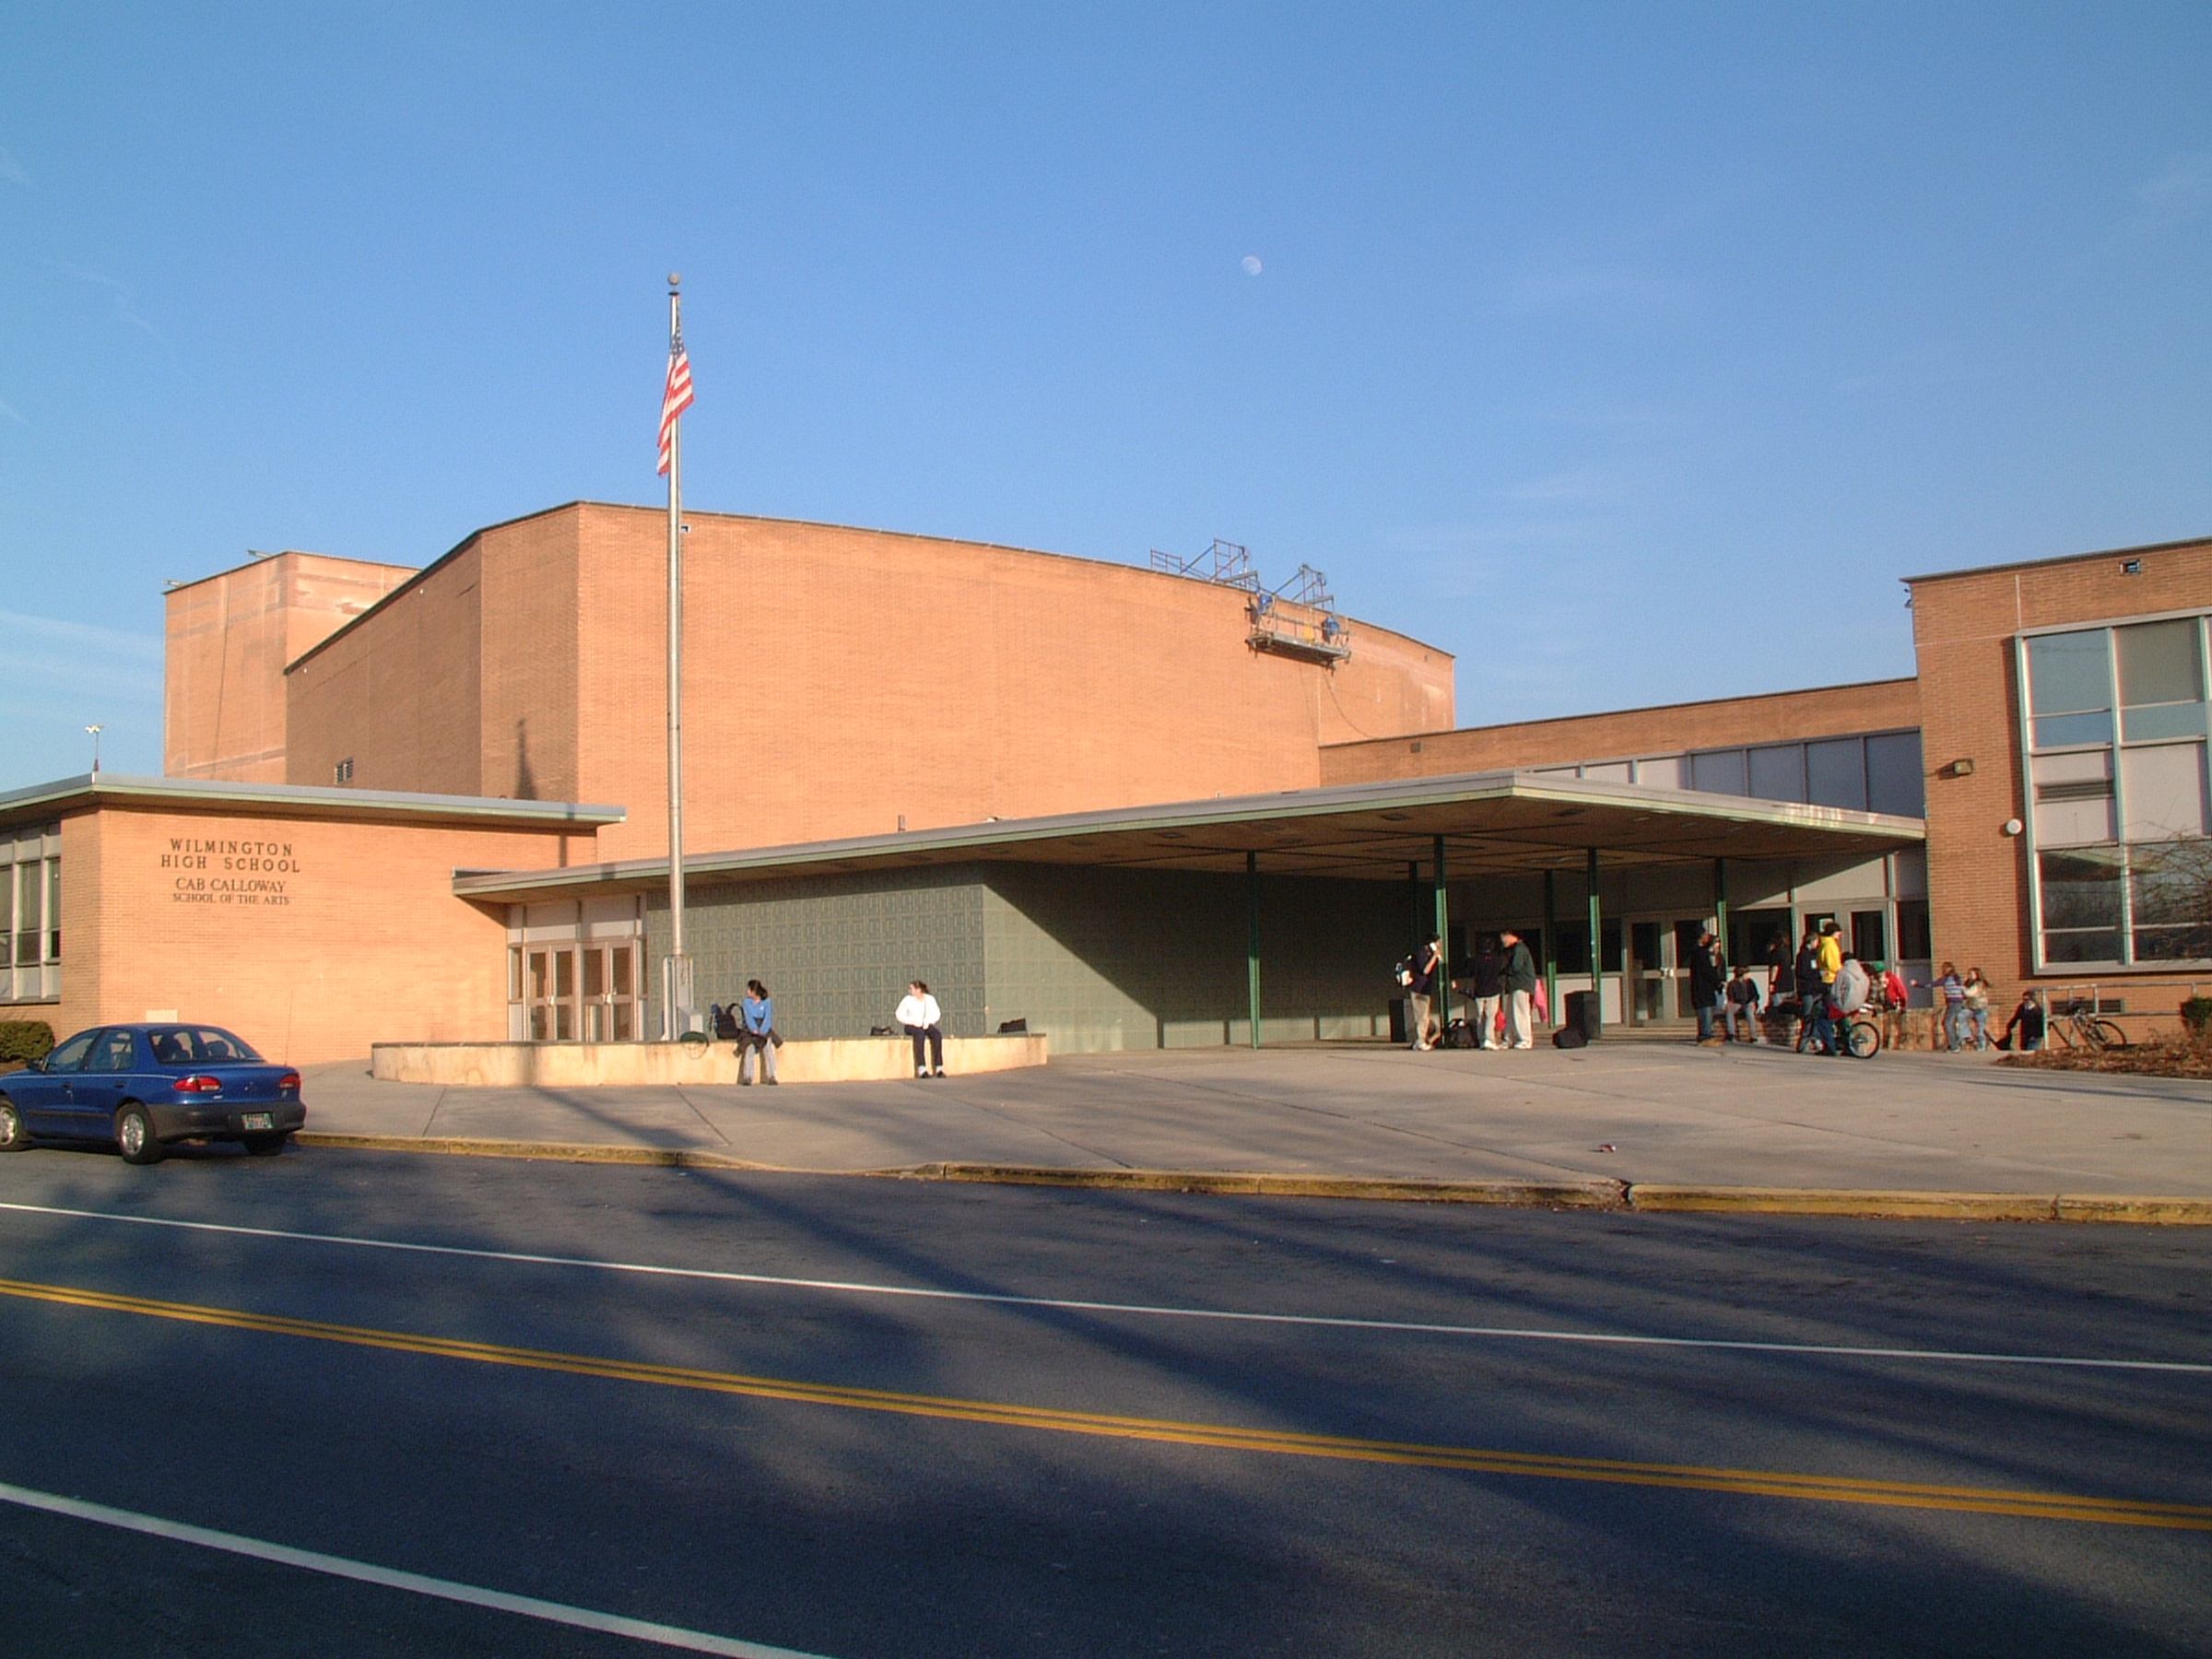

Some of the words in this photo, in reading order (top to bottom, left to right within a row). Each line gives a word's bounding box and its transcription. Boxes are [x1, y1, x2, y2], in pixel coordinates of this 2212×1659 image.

[170, 838, 292, 856] WILMINGTON
[161, 854, 206, 869] HIGH
[224, 857, 300, 873] SCHOOL
[175, 877, 206, 891] CAB
[210, 878, 287, 893] CALLOWAY
[173, 893, 217, 903] SCHOOL
[219, 894, 234, 904] OF
[238, 895, 258, 905] THE
[264, 896, 289, 905] ARTS
